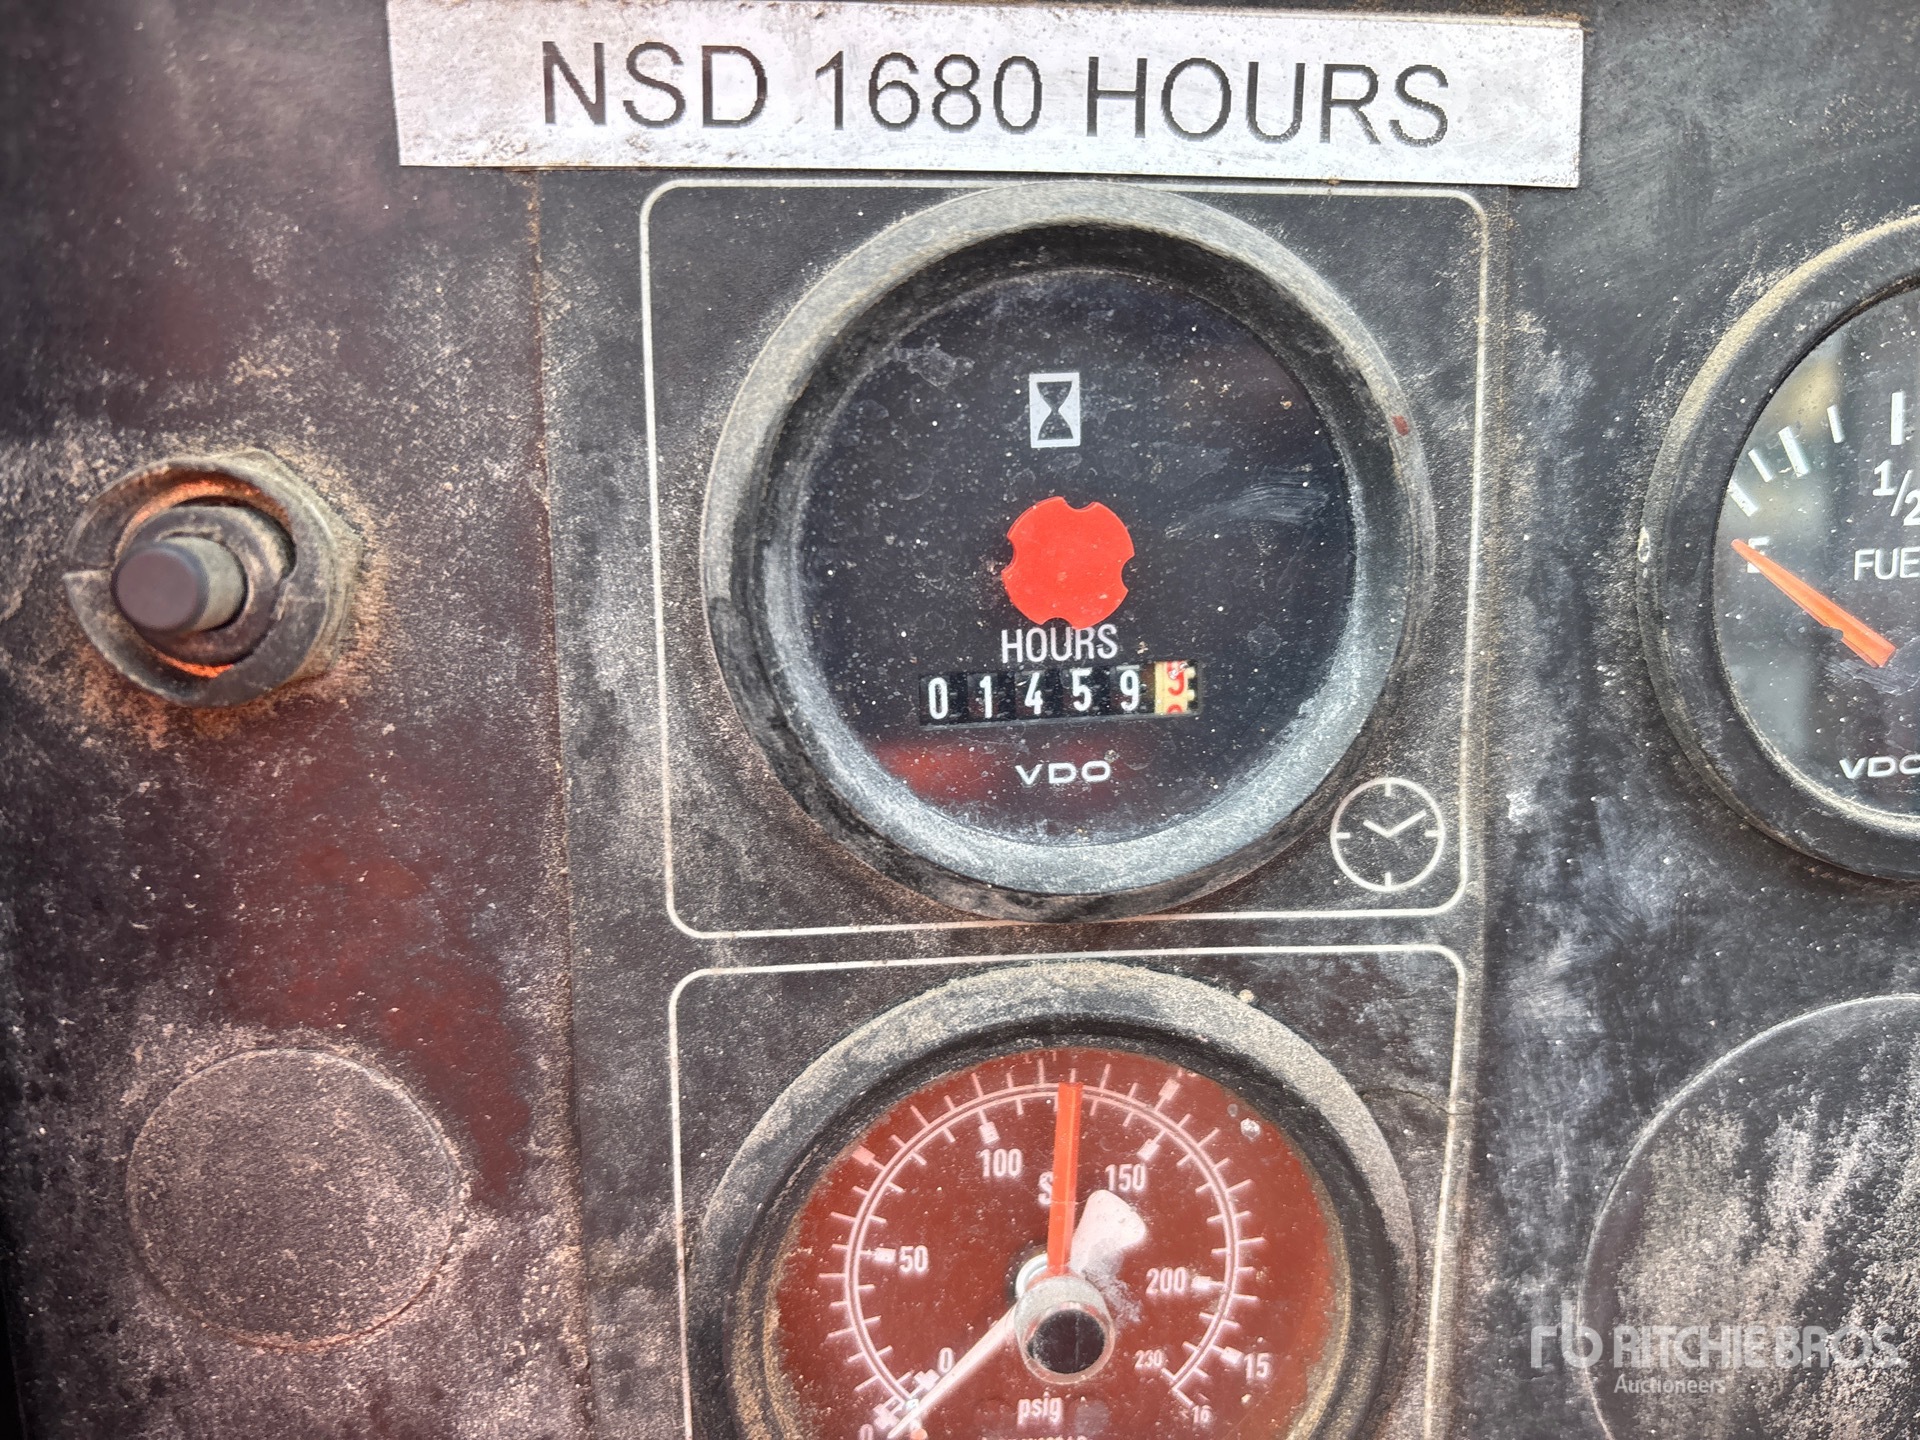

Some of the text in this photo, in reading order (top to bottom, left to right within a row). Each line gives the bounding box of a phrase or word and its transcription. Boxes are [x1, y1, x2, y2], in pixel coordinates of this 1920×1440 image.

[541, 41, 1449, 148] NSD 1680 HOURS
[1001, 624, 1118, 663] HOURS
[1015, 760, 1111, 785] VDO
[979, 1148, 1022, 1178] 100
[1105, 1163, 1147, 1192] 150
[900, 1245, 929, 1273] 50
[1145, 1266, 1187, 1295] 200
[1134, 1349, 1164, 1369] 230
[1244, 1352, 1272, 1379] 15
[1017, 1391, 1062, 1427] psig
